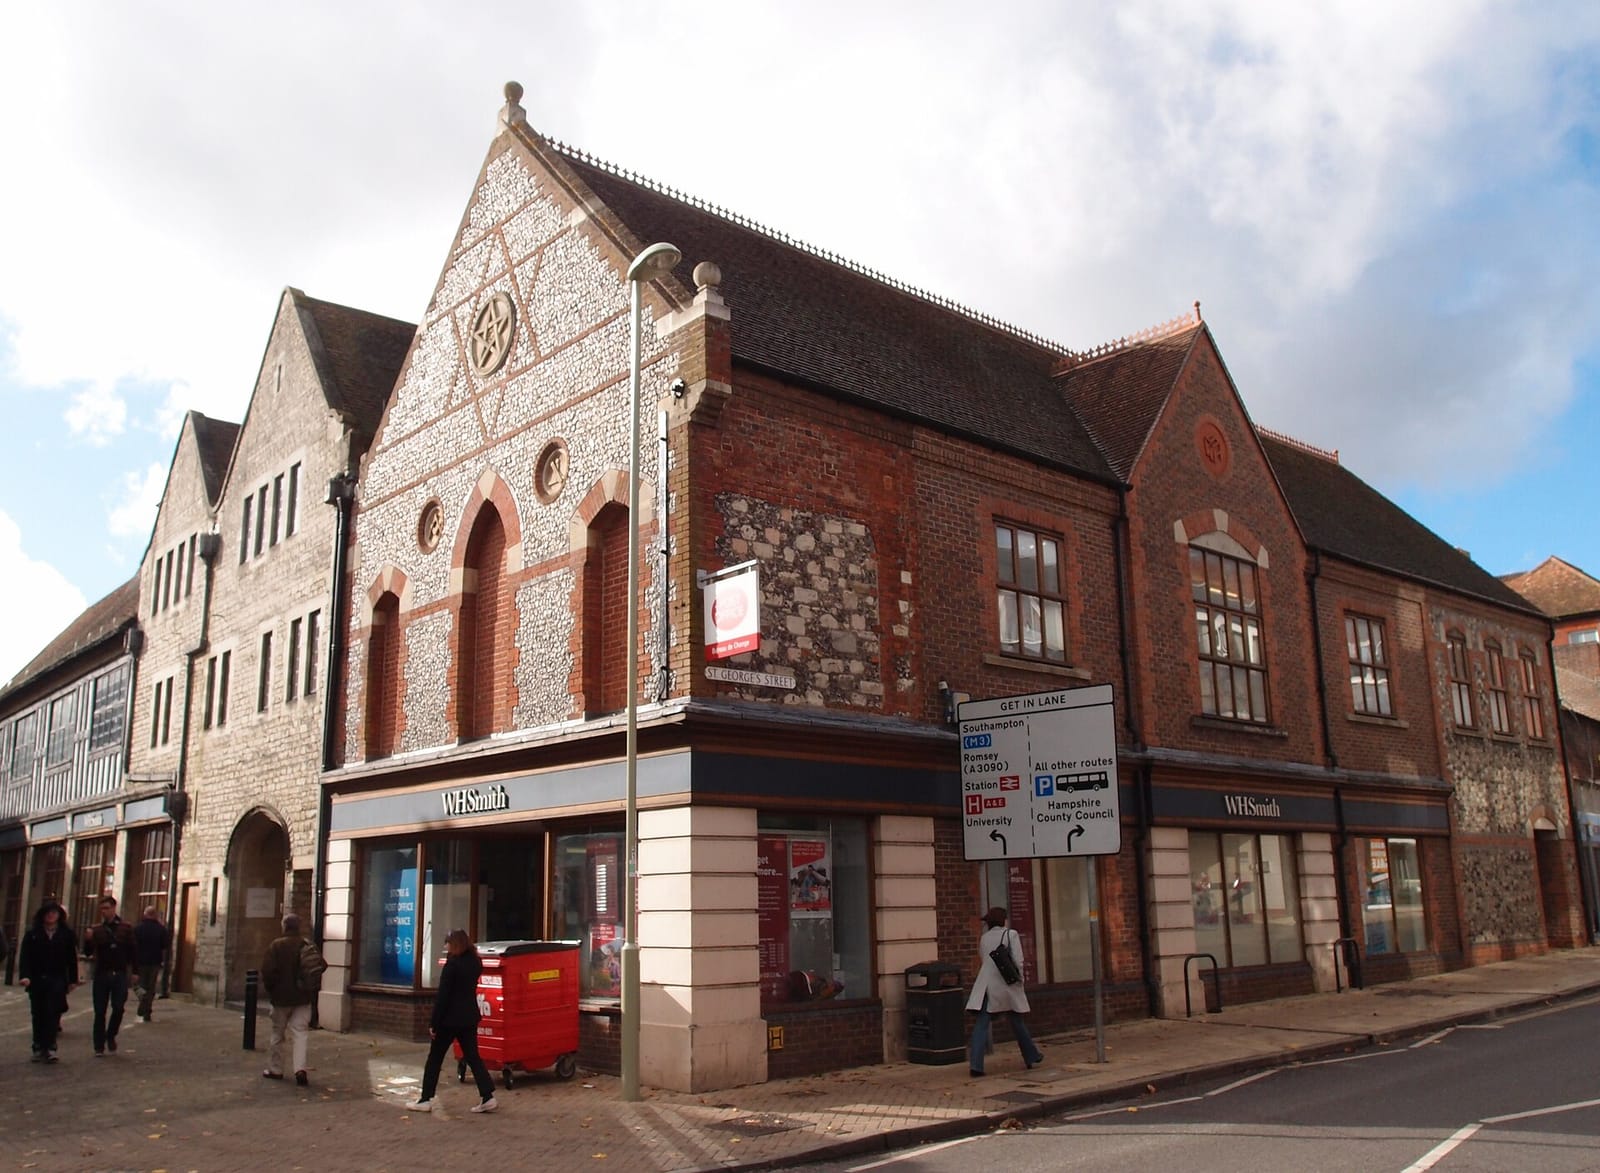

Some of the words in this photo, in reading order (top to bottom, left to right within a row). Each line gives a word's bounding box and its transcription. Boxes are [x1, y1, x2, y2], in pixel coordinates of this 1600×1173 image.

[707, 668, 717, 678] ST
[764, 675, 794, 687] STREET
[1000, 701, 1019, 711] GET
[1023, 699, 1035, 709] IN
[1038, 694, 1066, 707] LANE
[962, 719, 1025, 734] Southampton
[964, 735, 992, 749] (M3)
[963, 752, 999, 763] Romsey
[1035, 760, 1048, 772] All
[1051, 758, 1077, 770] other
[1080, 757, 1113, 768] routes
[963, 761, 1009, 775] (A3090)
[965, 780, 998, 791] Station
[1039, 777, 1051, 795] P
[441, 785, 506, 815] WHSmith
[967, 796, 980, 813] H
[985, 799, 1004, 808] A&E
[1048, 798, 1101, 811] Hampshire
[1224, 795, 1280, 817] WHSmith
[966, 816, 1013, 828] University
[1036, 811, 1072, 824] County
[1075, 808, 1114, 820] Council
